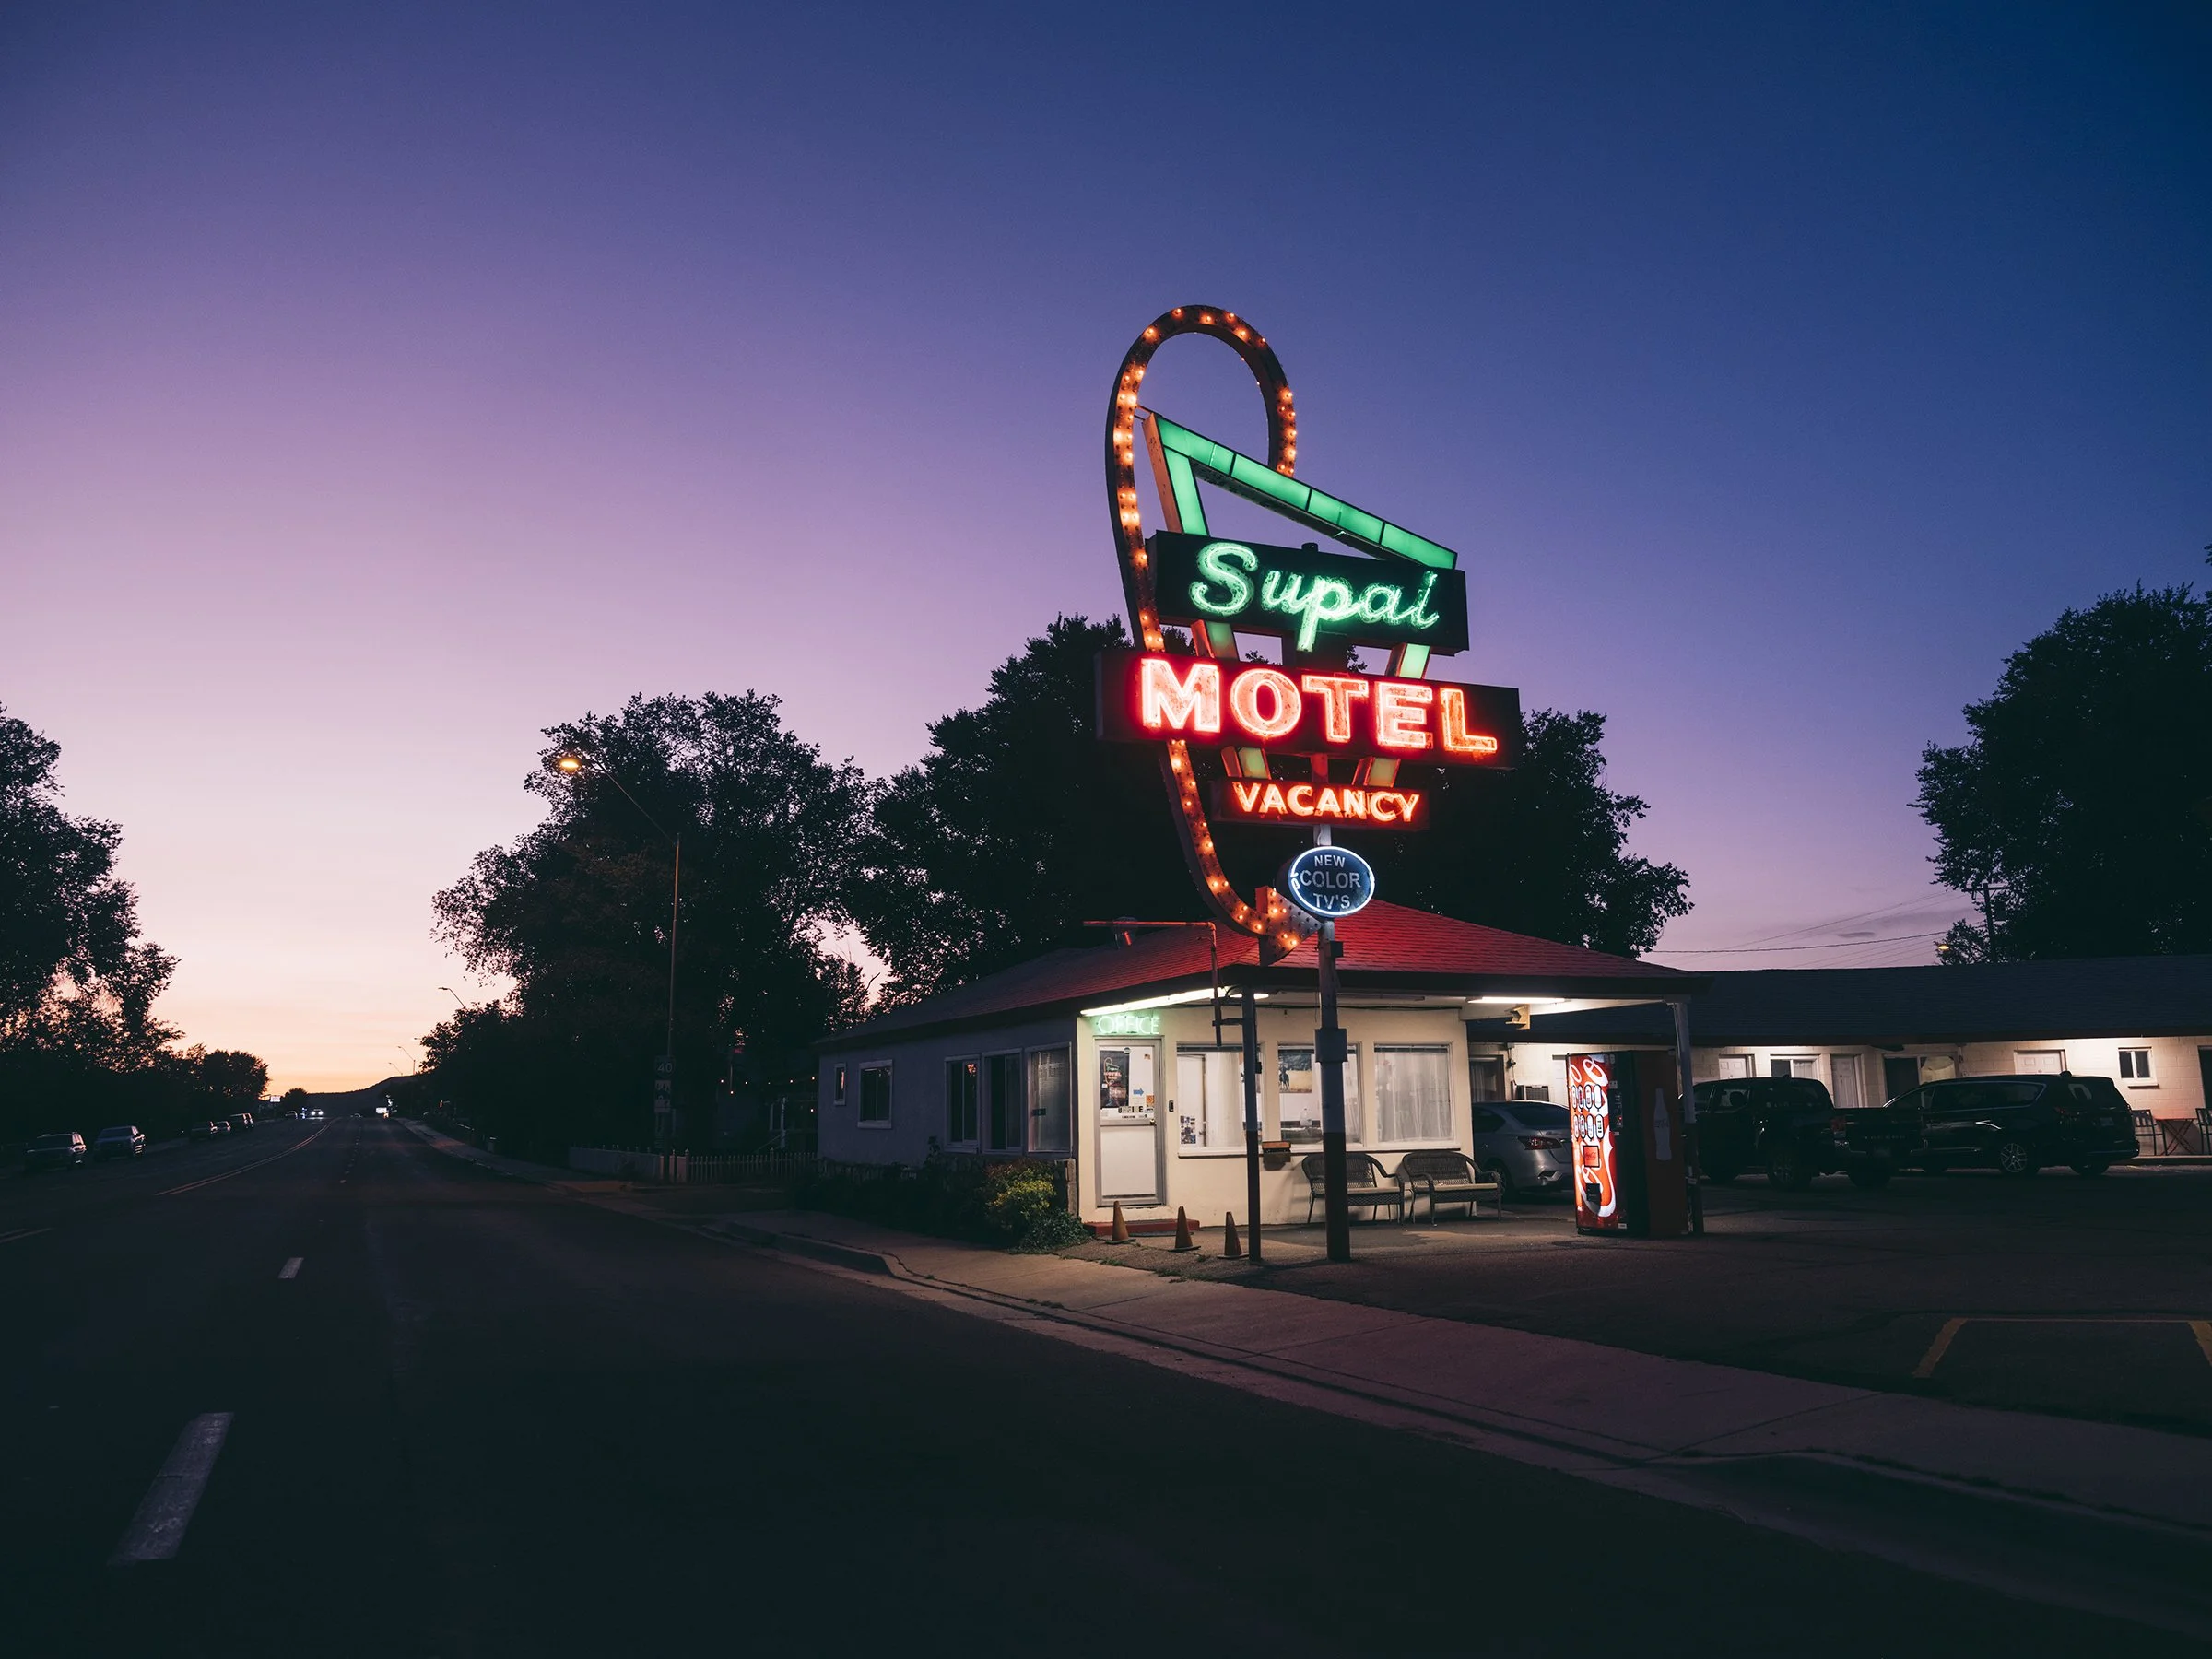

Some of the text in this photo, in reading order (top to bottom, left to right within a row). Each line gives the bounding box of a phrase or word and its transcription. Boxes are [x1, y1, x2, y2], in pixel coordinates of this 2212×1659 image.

[1189, 542, 1439, 653] Supai
[1140, 658, 1498, 754] MOTEL
[1232, 782, 1419, 823] VACANCY
[1314, 854, 1346, 868] NEW
[1299, 869, 1361, 888] COLOR
[1313, 892, 1351, 910] TV'S
[1098, 1016, 1160, 1034] OFFICE
[657, 1063, 673, 1073] 40
